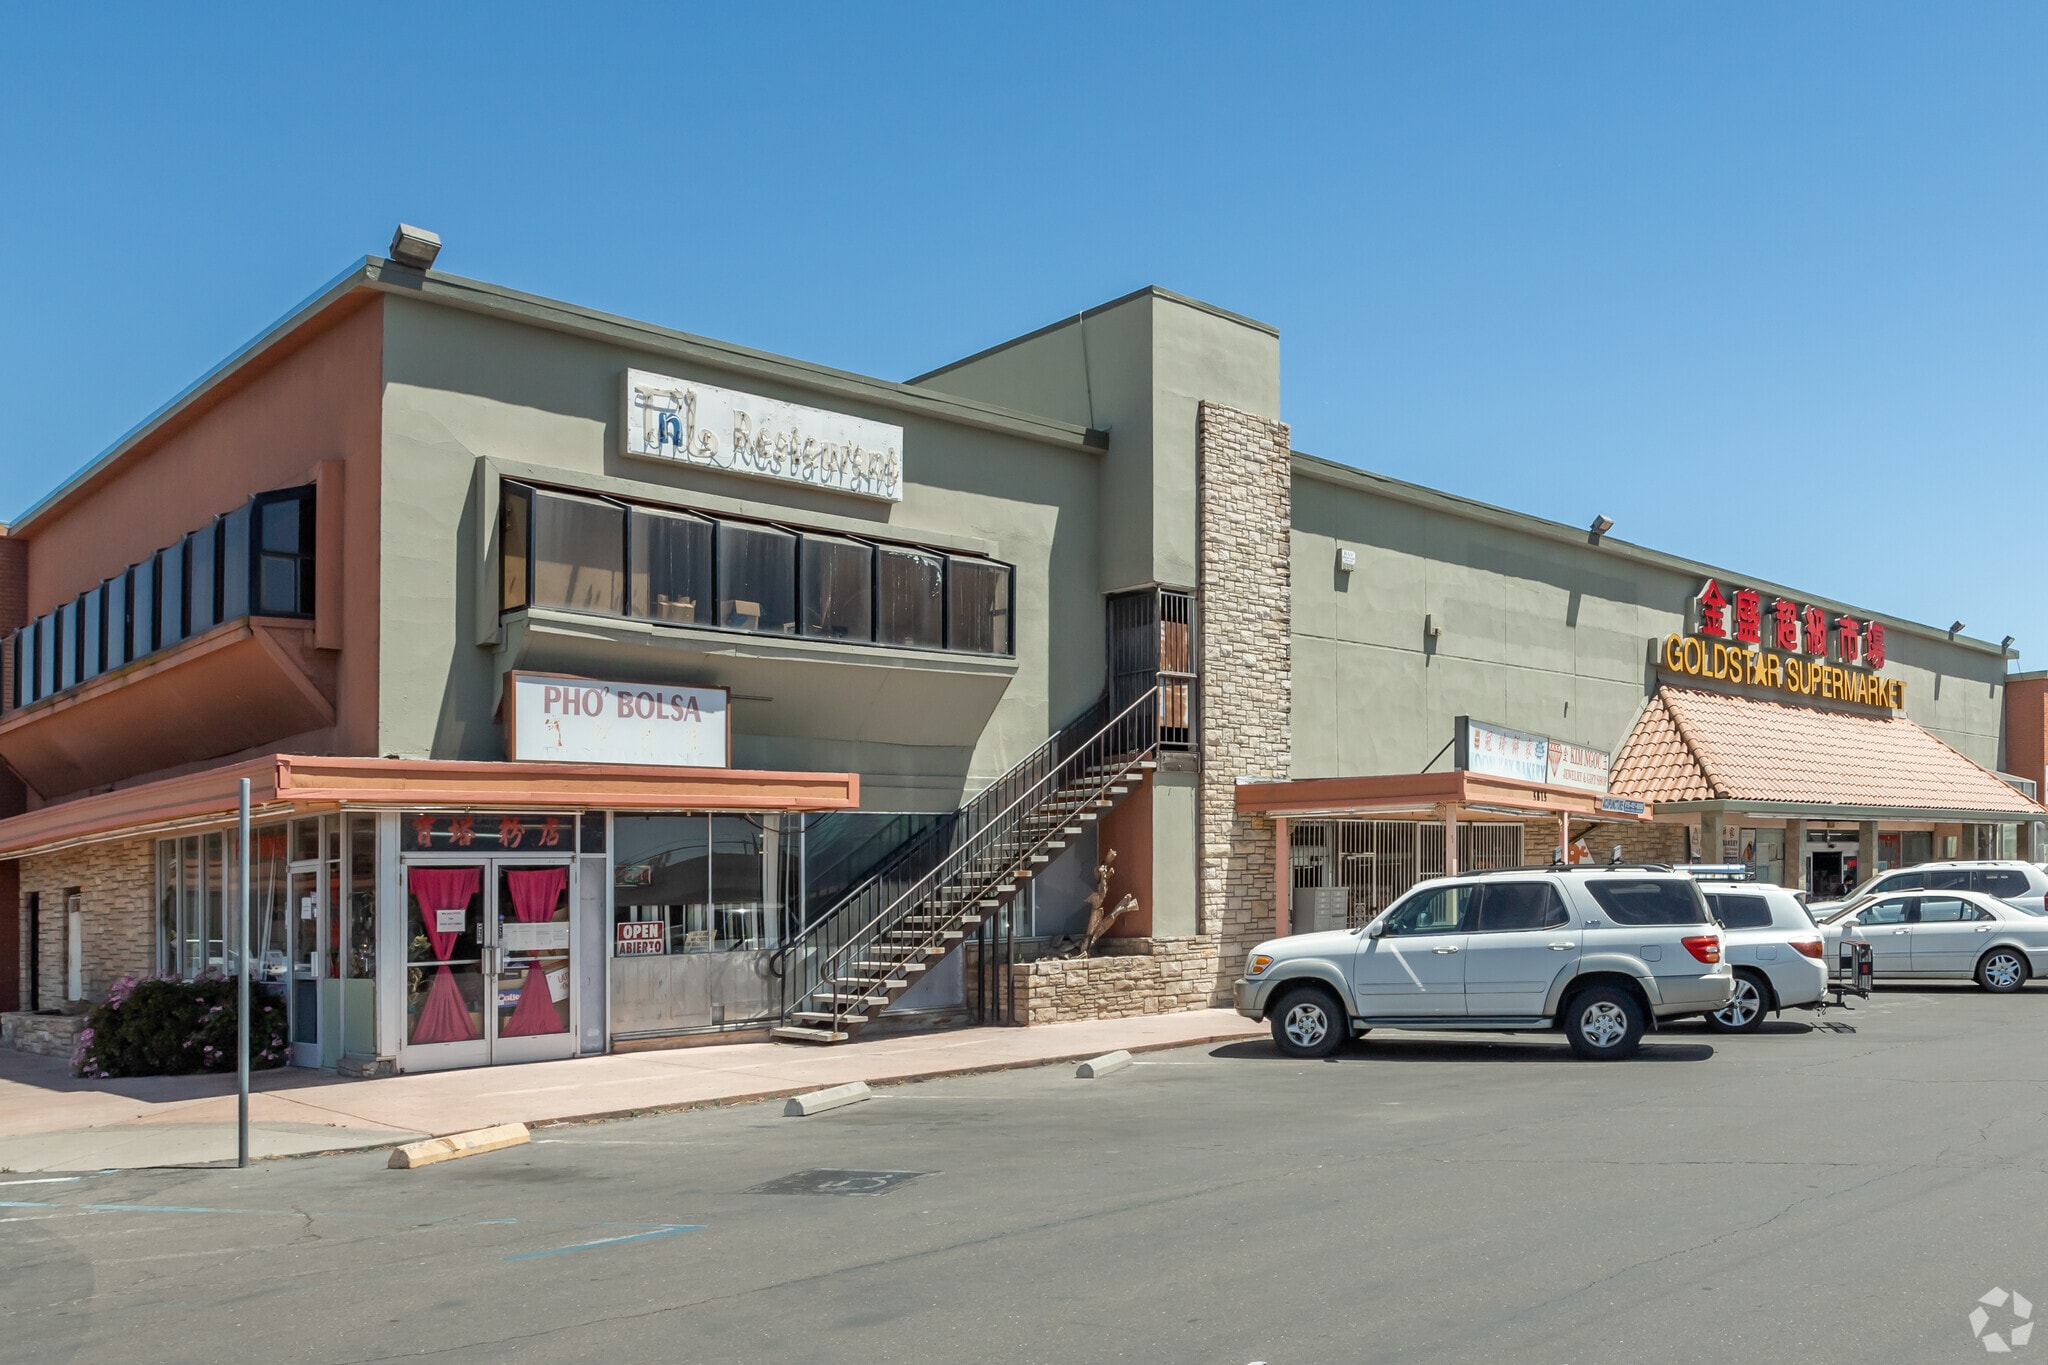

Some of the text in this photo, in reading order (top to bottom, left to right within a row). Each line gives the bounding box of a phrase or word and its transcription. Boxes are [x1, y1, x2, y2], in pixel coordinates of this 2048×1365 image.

[733, 409, 898, 487] Restaurant
[1665, 633, 1907, 709] GOLDSTAR SUPERMARKET
[617, 690, 702, 722] BOLSA
[1516, 760, 1546, 781] BAKERY
[623, 924, 659, 939] OPEN
[620, 940, 662, 954] ABIERTO
